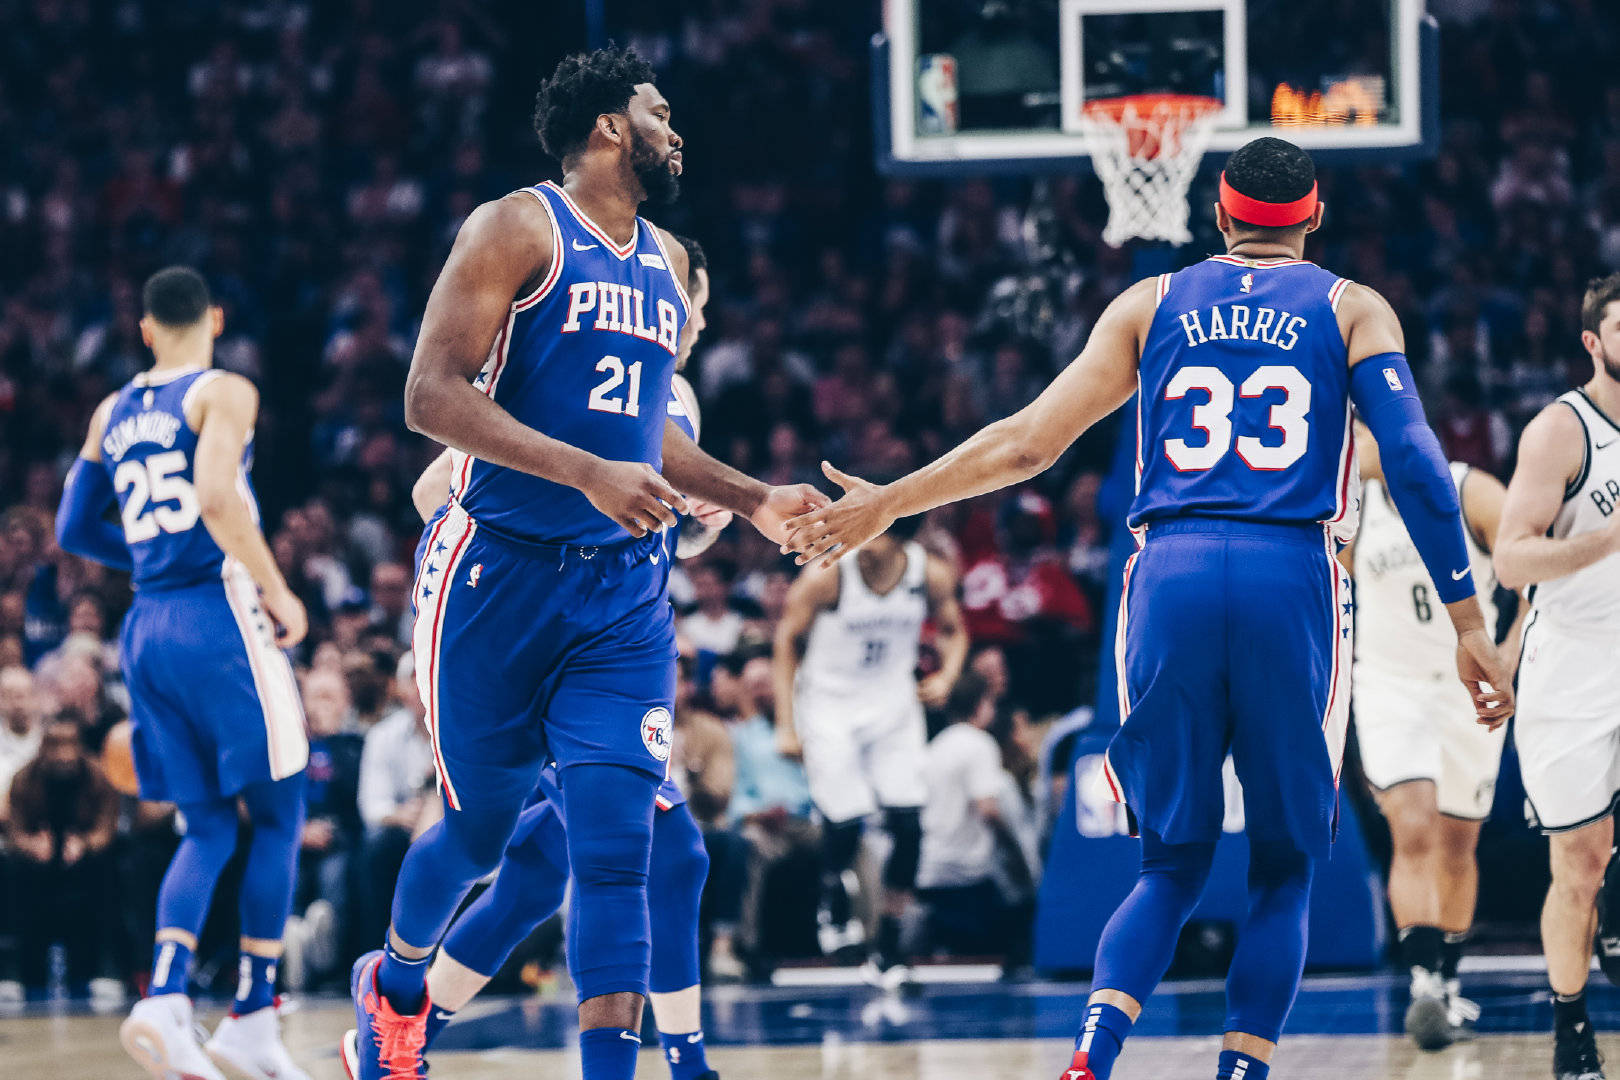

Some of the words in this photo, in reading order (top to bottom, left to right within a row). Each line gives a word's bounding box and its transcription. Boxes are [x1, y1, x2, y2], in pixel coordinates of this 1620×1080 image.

[560, 281, 678, 357] PHILA
[1178, 304, 1307, 351] HARRIS
[587, 354, 643, 417] 21
[1164, 365, 1312, 472] 33
[113, 449, 201, 545] 25
